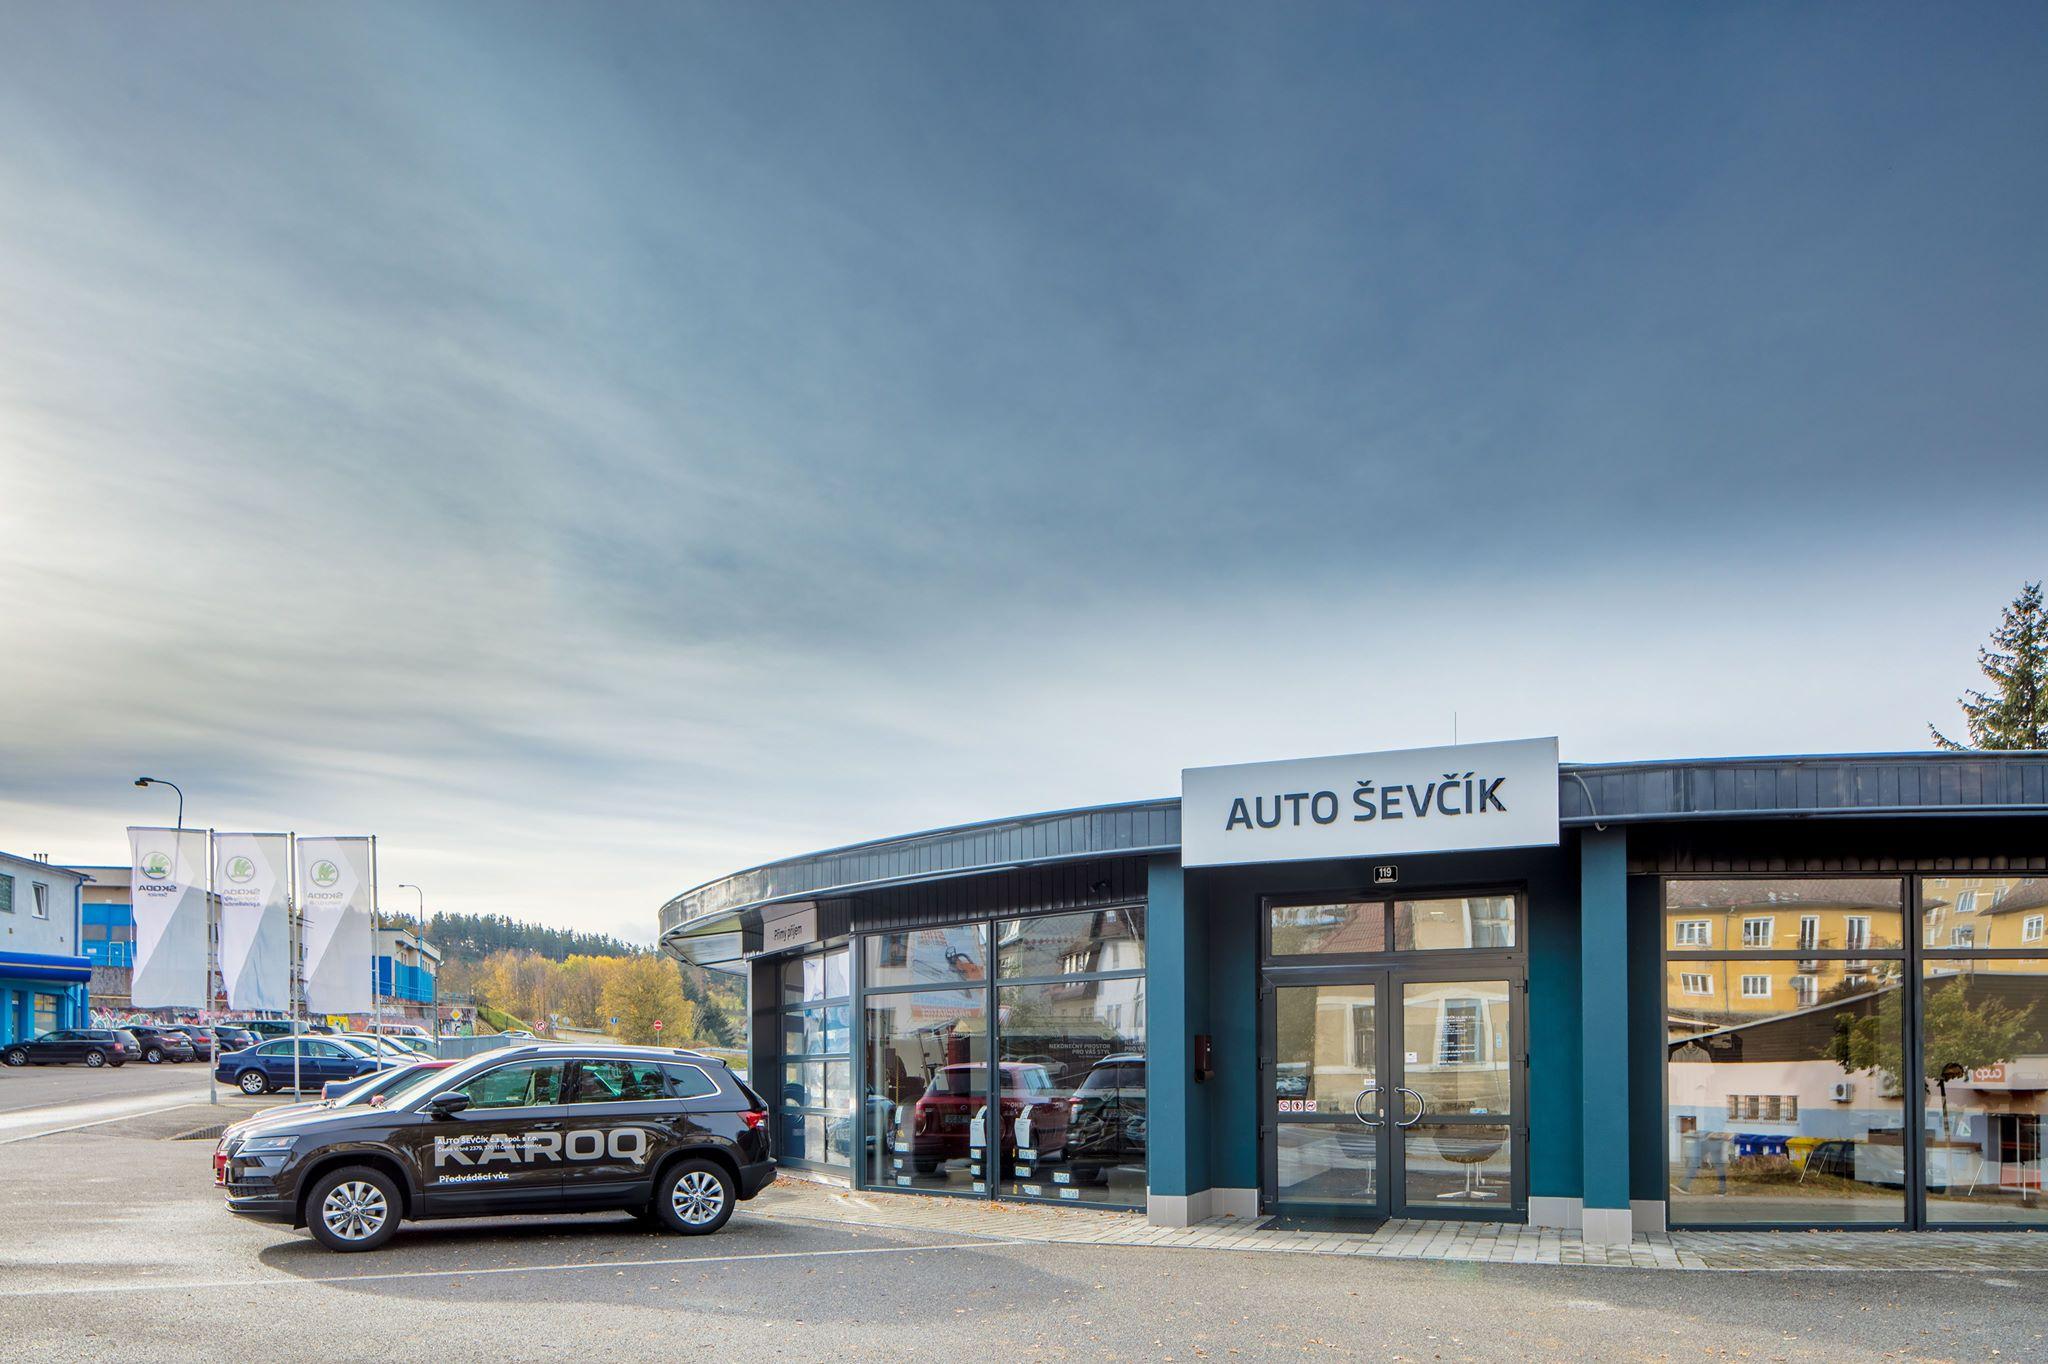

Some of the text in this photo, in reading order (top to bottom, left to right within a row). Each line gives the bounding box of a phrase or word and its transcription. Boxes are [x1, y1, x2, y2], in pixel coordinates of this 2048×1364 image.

[1225, 771, 1507, 831] AUTO ŠEVČÍK
[1379, 867, 1392, 877] 119
[437, 1138, 460, 1146] AUTO
[461, 1135, 489, 1145] ŠEVČÍK
[434, 1128, 647, 1167] KAROQ
[439, 1171, 510, 1183] Předváděcí vůz
